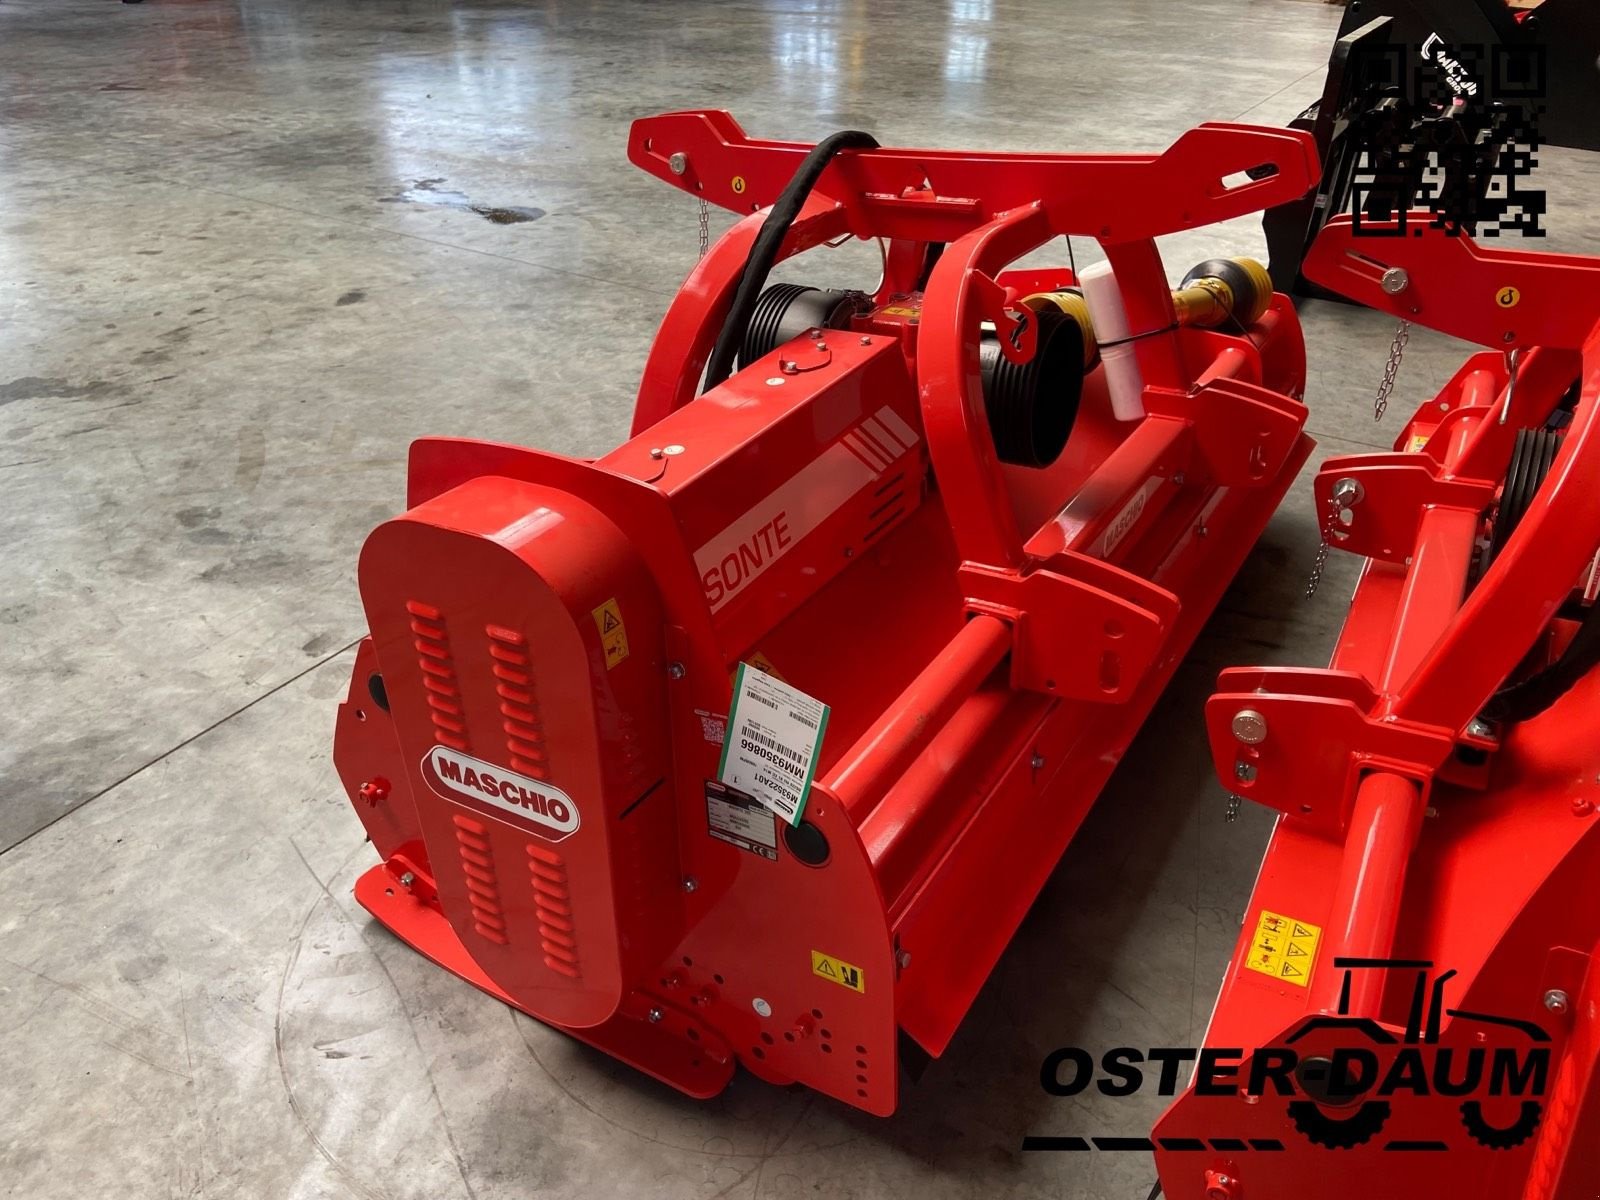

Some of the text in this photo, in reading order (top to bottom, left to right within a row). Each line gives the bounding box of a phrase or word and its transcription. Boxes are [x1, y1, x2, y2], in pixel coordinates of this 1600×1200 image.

[702, 511, 792, 606] SONTE
[740, 737, 804, 779] MM9350866
[438, 757, 570, 822] MASCHIO
[753, 771, 798, 804] M93522A01
